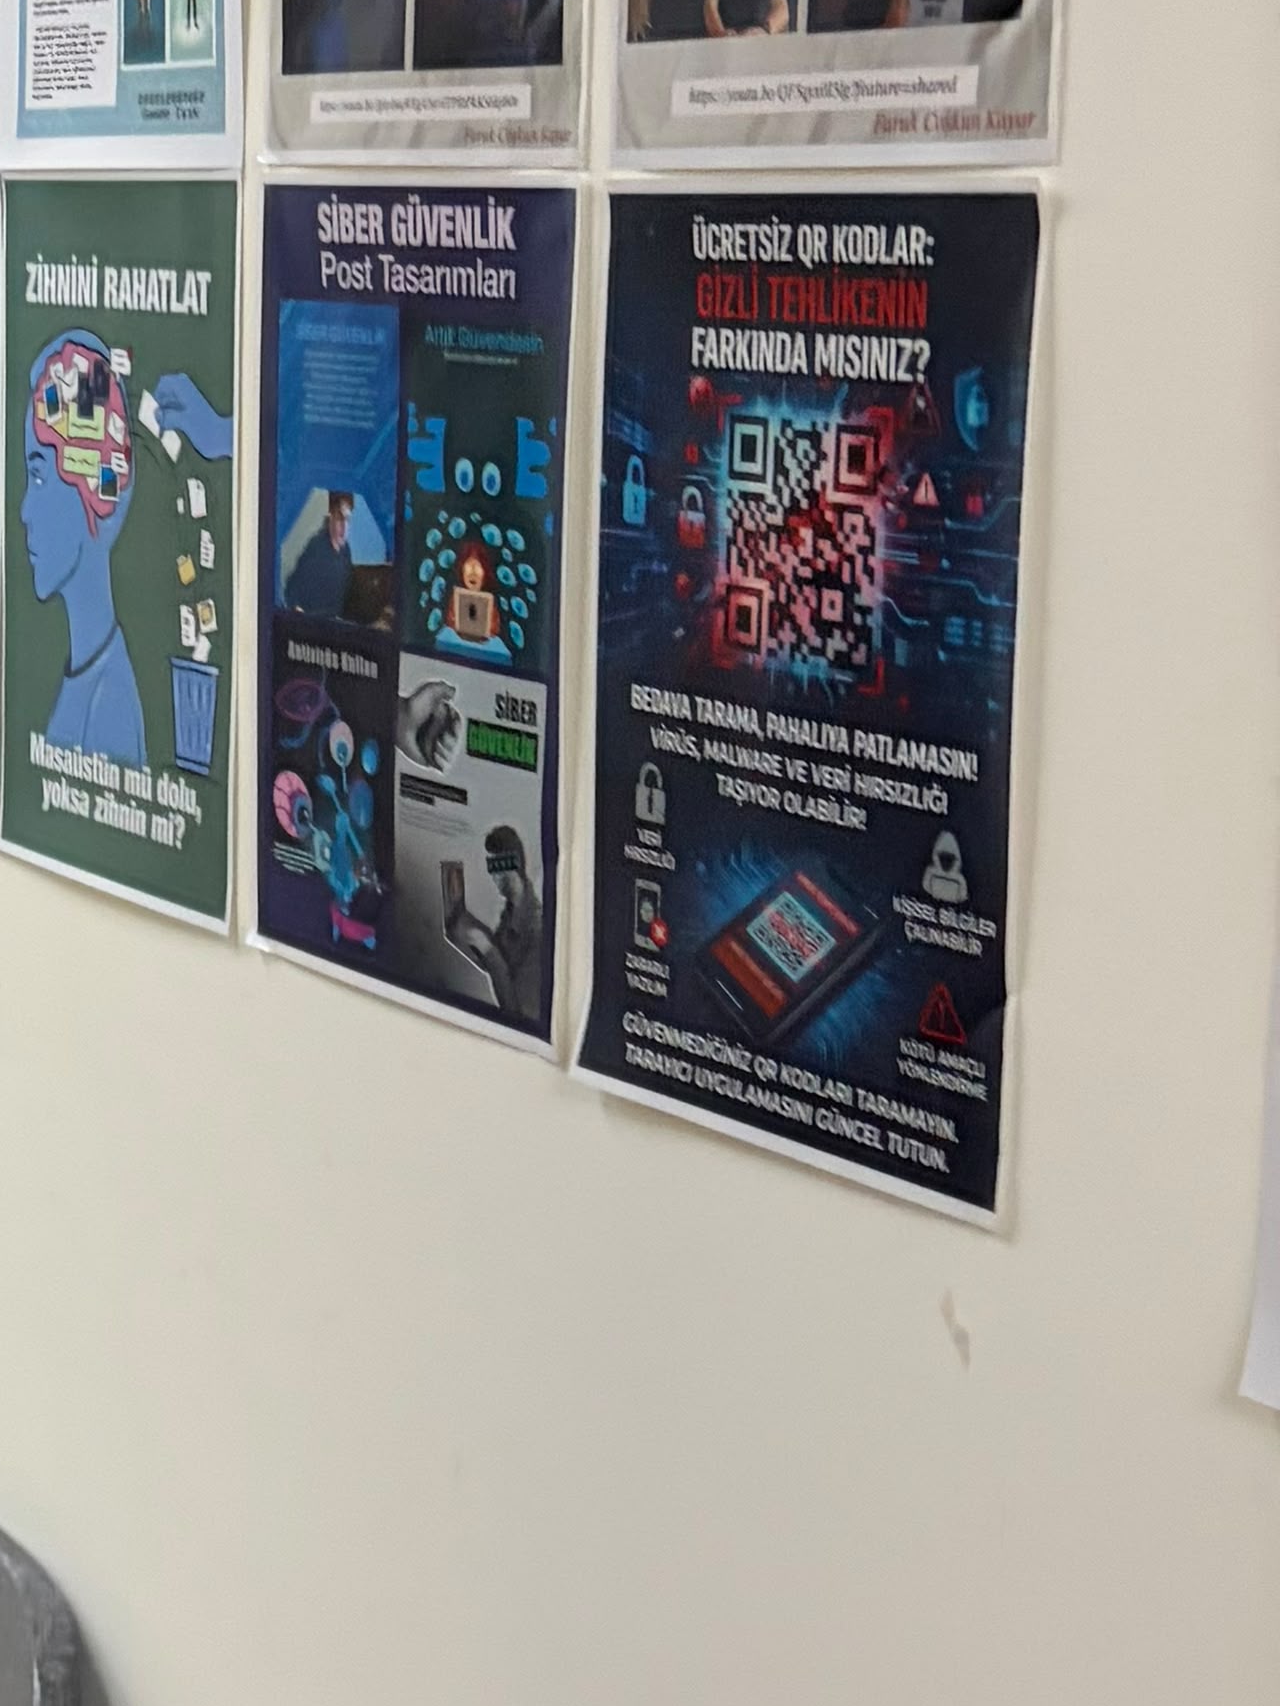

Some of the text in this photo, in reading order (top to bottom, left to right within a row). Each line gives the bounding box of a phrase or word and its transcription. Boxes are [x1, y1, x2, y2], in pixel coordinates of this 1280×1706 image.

[317, 193, 517, 251] SİBER GÜVENLİK
[692, 214, 935, 269] ÜCRETSİZ QR KODLAR:
[26, 254, 212, 316] ZİHNİNİ RAHATLAT
[319, 250, 516, 300] Post Tasarımları
[696, 263, 929, 328] GİZLİ TEHLİKENİN
[691, 326, 931, 384] FARKINDA MISINIZ?
[495, 690, 538, 727] SİBER
[631, 683, 979, 782] BEDAVA TARAMA, PAHALIYA PATLAMASIN!
[124, 765, 152, 803] mü
[703, 738, 784, 778] MALWARE
[785, 756, 808, 783] VE
[810, 762, 852, 793] VERİ
[853, 771, 949, 815] HIRSIZLIĞI
[715, 772, 781, 807] TAŞIYOR
[42, 777, 90, 819] yoksa
[93, 793, 146, 839] zihnin
[151, 807, 186, 850] mi?
[753, 1054, 778, 1083] QR
[779, 1061, 853, 1107] KODLARI
[887, 1129, 950, 1174] TUTUN.
